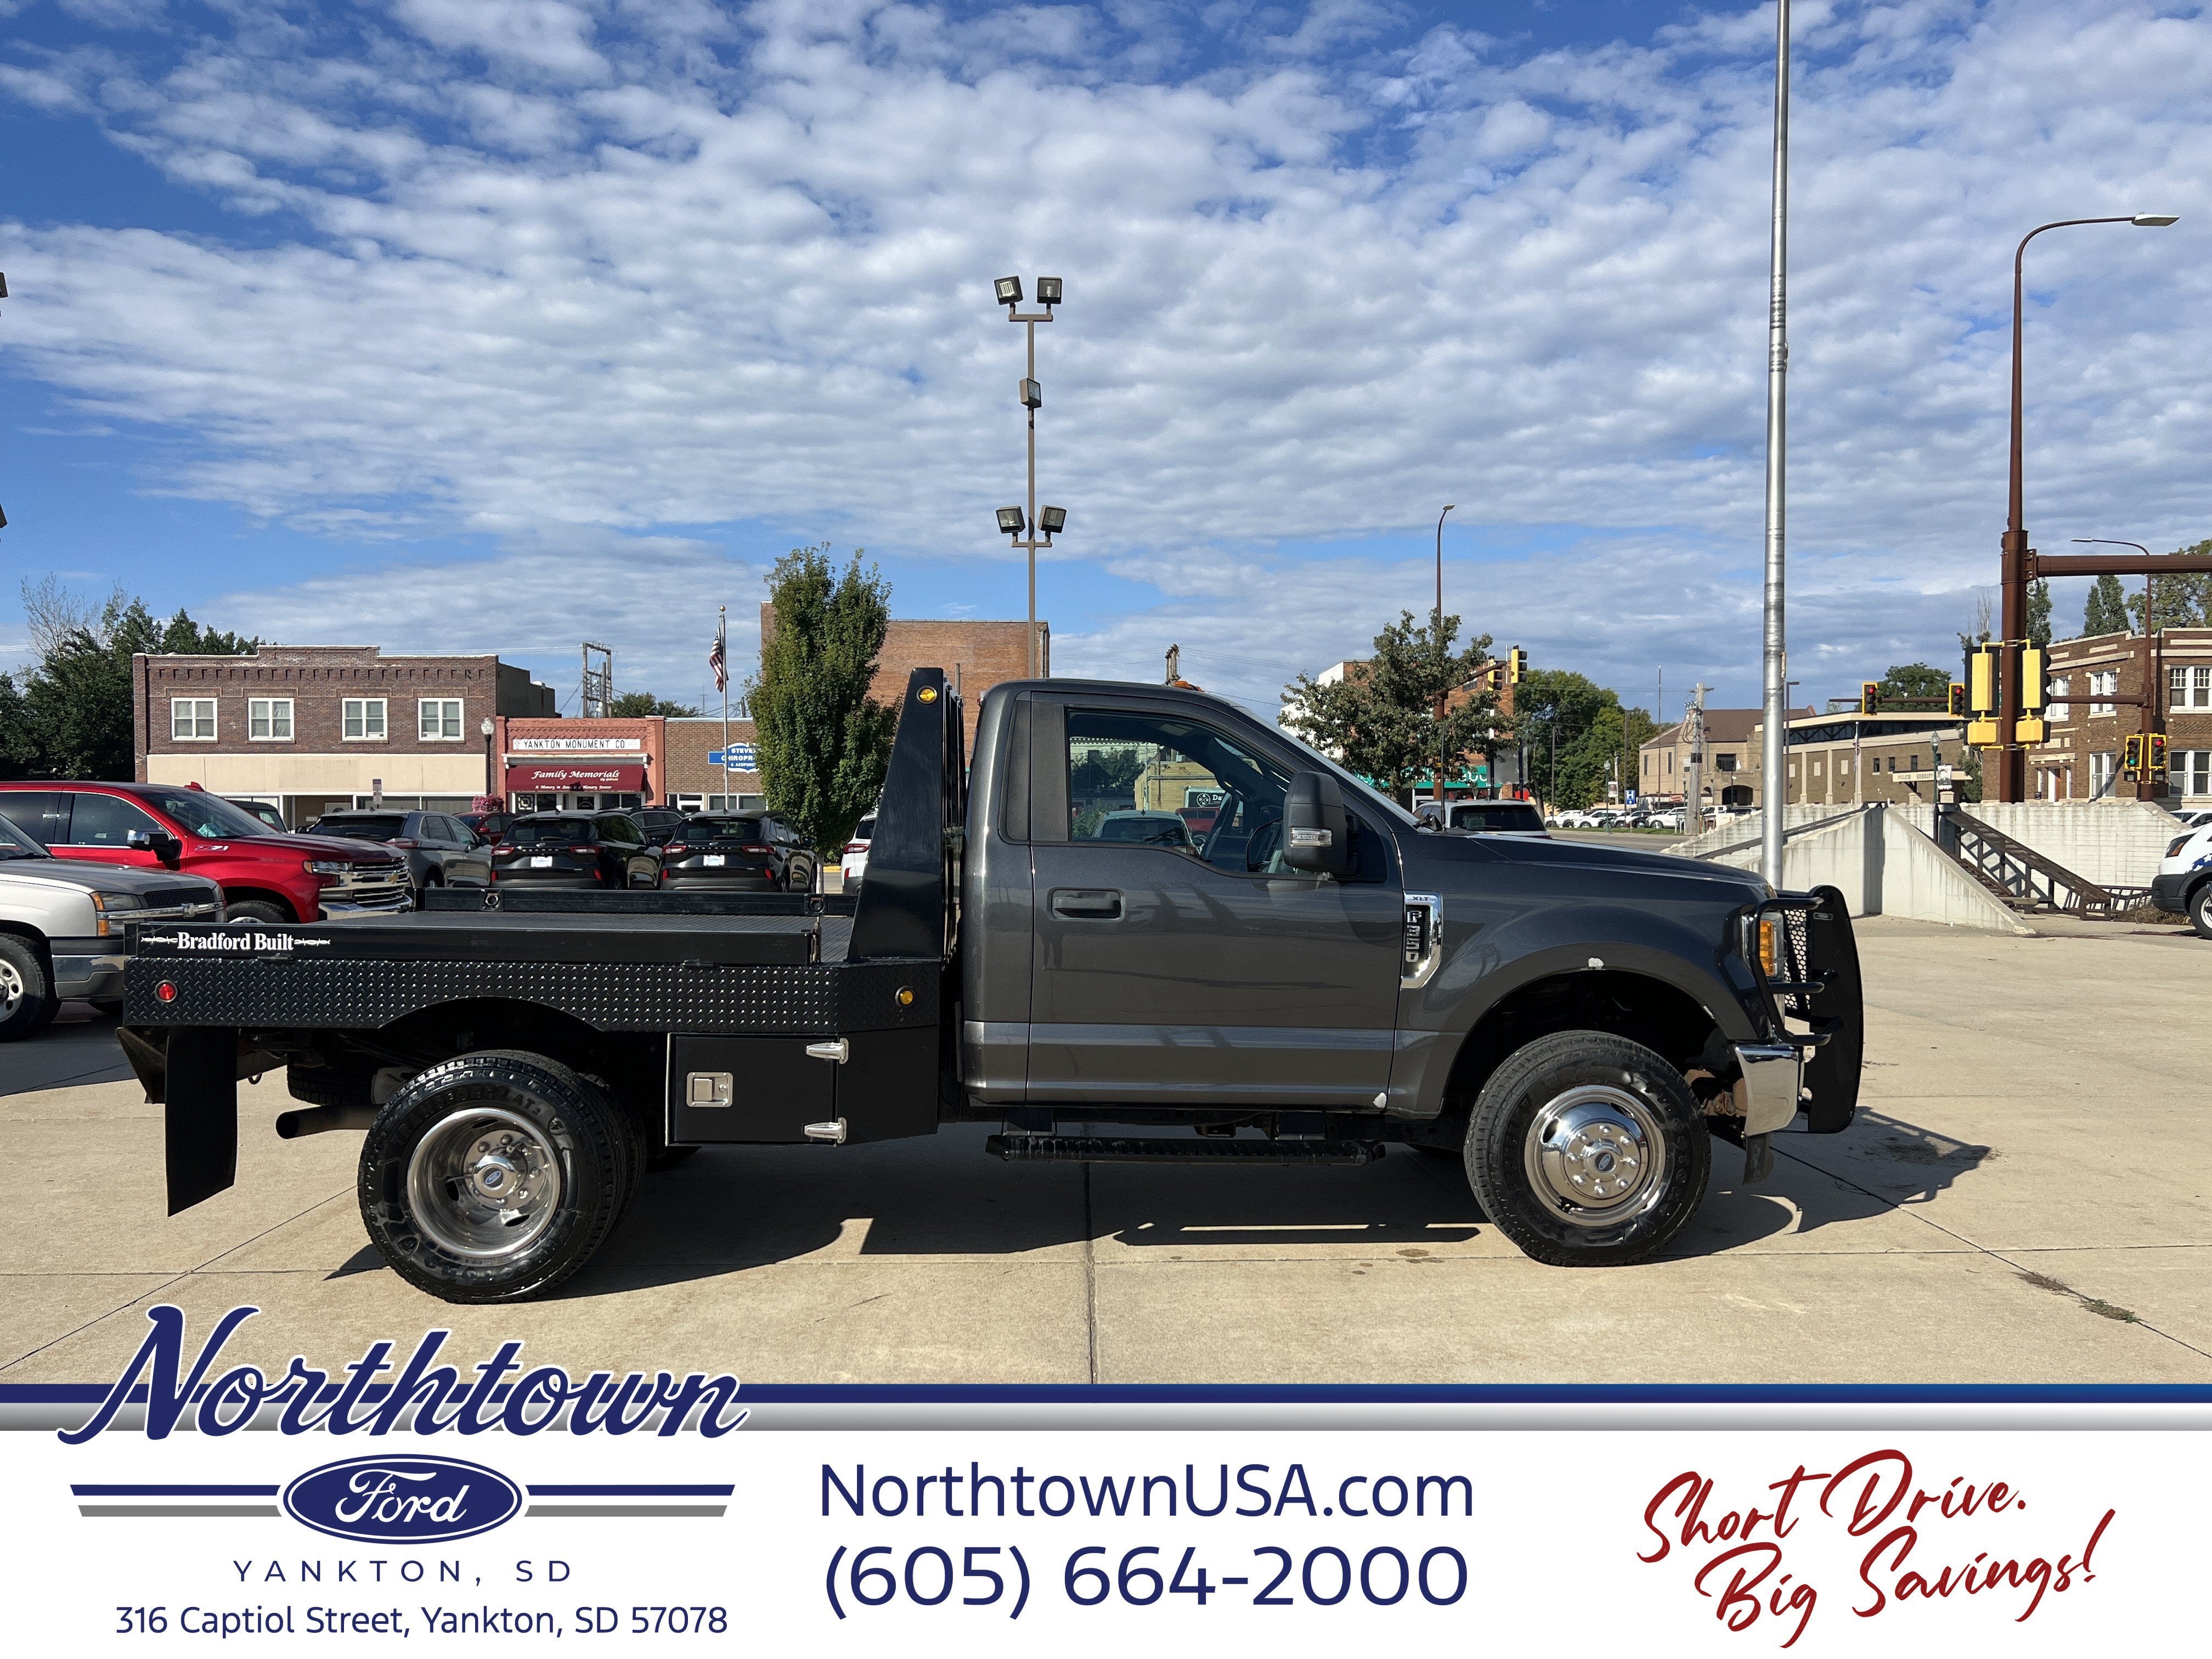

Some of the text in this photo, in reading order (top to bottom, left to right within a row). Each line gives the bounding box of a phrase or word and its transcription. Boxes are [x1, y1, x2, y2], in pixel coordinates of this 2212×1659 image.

[524, 740, 625, 749] YANKTON MONUMENT CO
[531, 770, 620, 780] Family Memorials
[1626, 790, 1634, 799] H
[177, 932, 294, 950] Bradford Built
